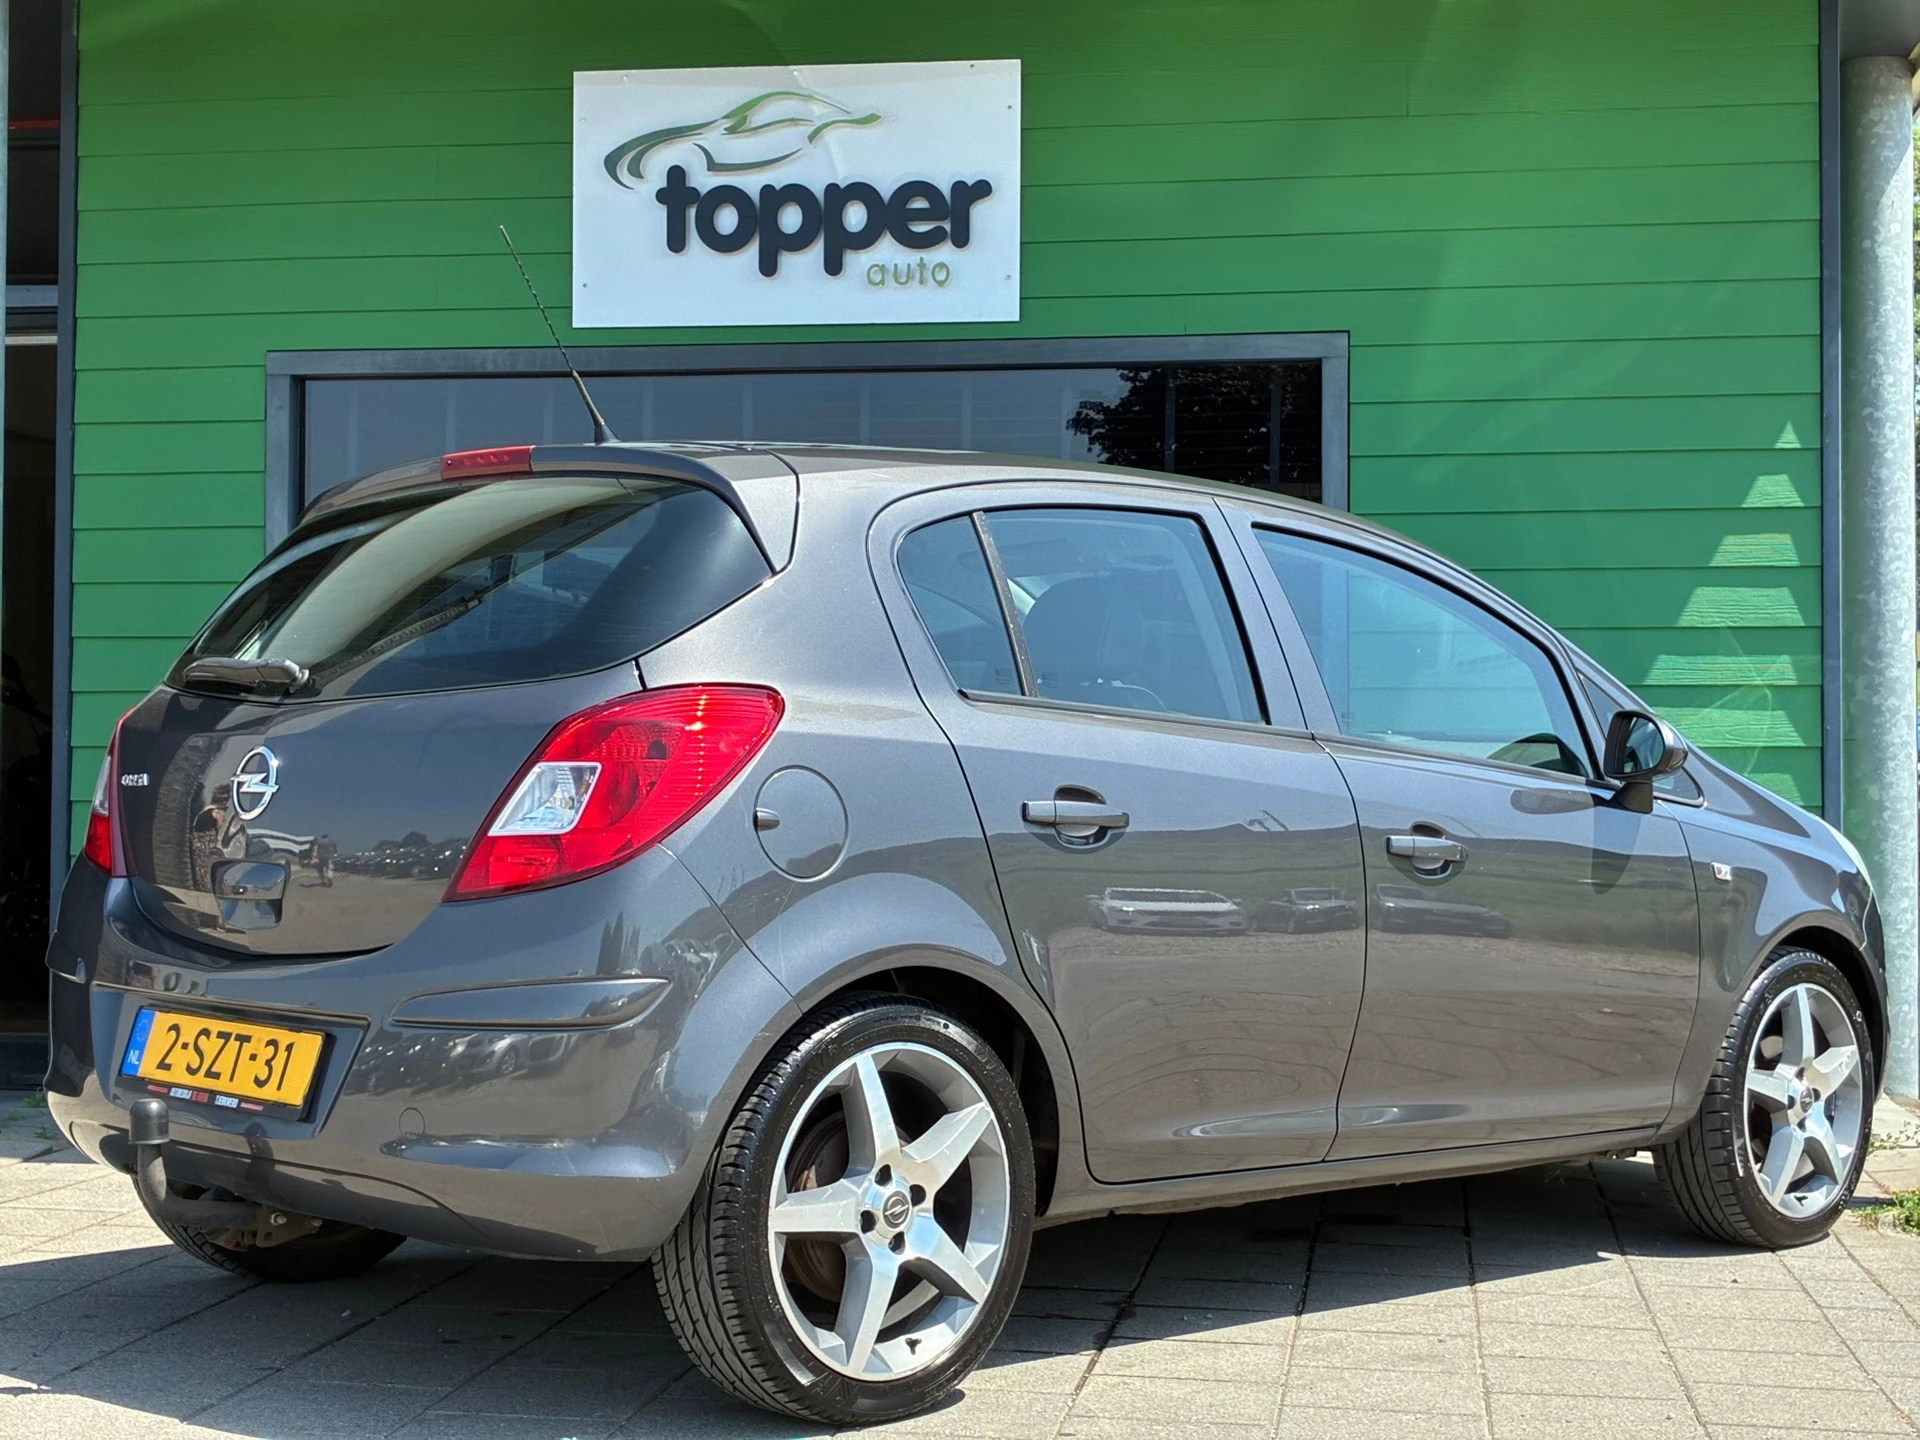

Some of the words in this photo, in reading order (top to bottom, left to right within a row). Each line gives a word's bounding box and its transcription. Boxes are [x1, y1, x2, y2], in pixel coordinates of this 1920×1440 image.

[656, 165, 992, 277] topper
[866, 256, 951, 287] auto
[127, 1049, 140, 1065] NL
[156, 1023, 296, 1091] 2-SZT-31
